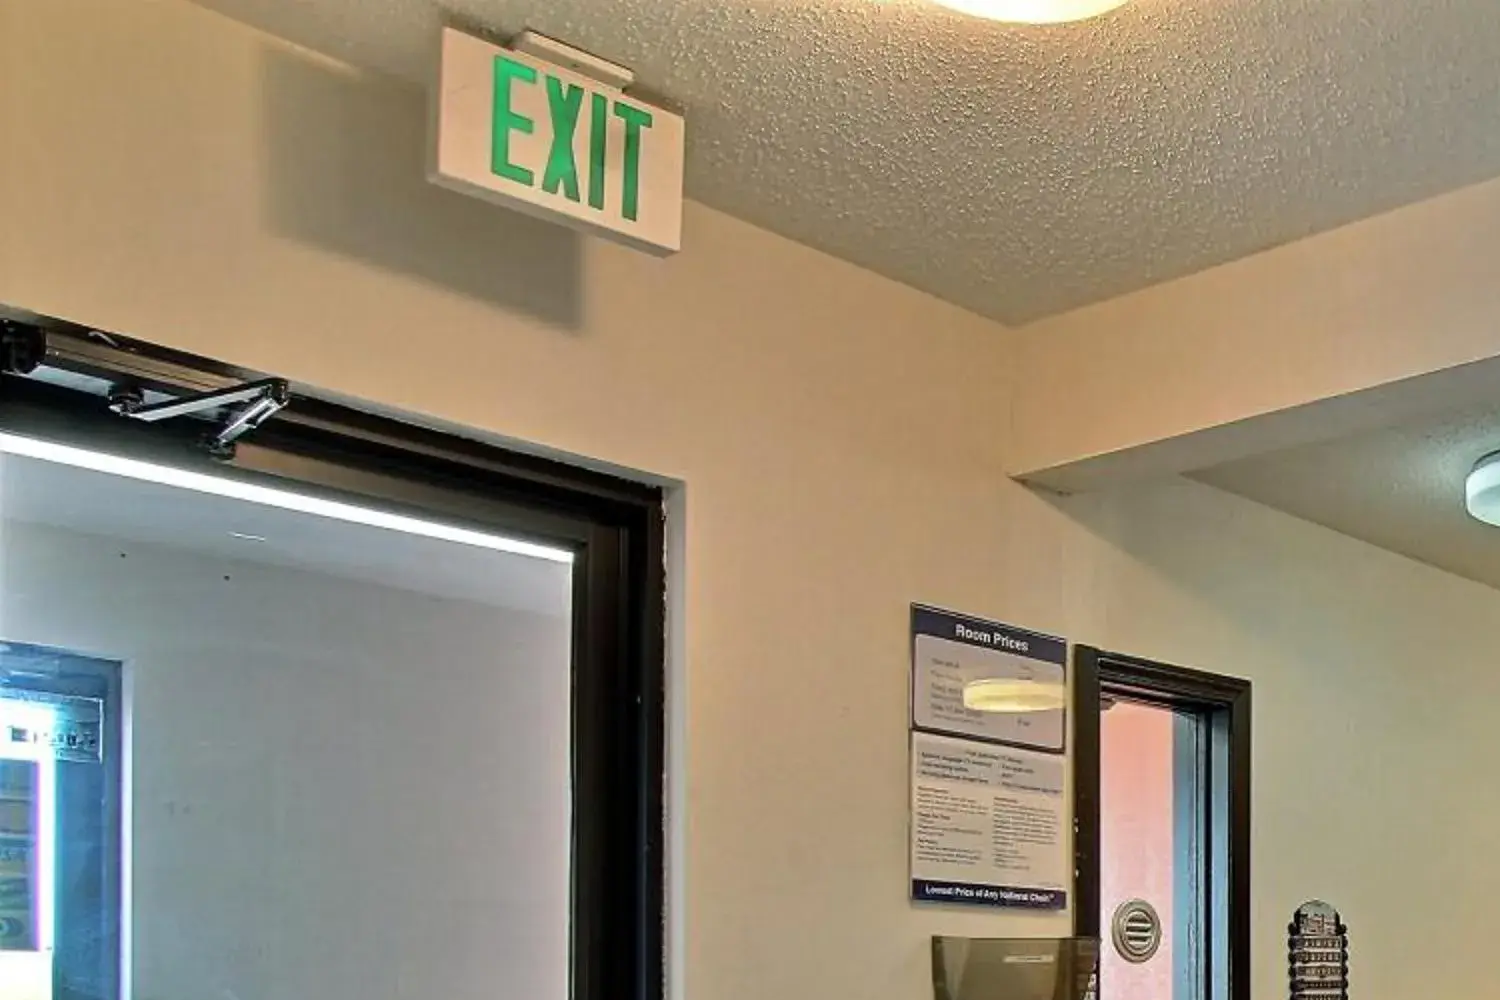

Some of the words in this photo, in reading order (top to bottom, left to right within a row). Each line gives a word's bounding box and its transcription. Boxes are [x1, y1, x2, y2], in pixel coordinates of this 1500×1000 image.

[490, 54, 653, 222] EXIT
[955, 623, 991, 643] Room
[993, 632, 1029, 652] Prices
[955, 887, 975, 898] Price
